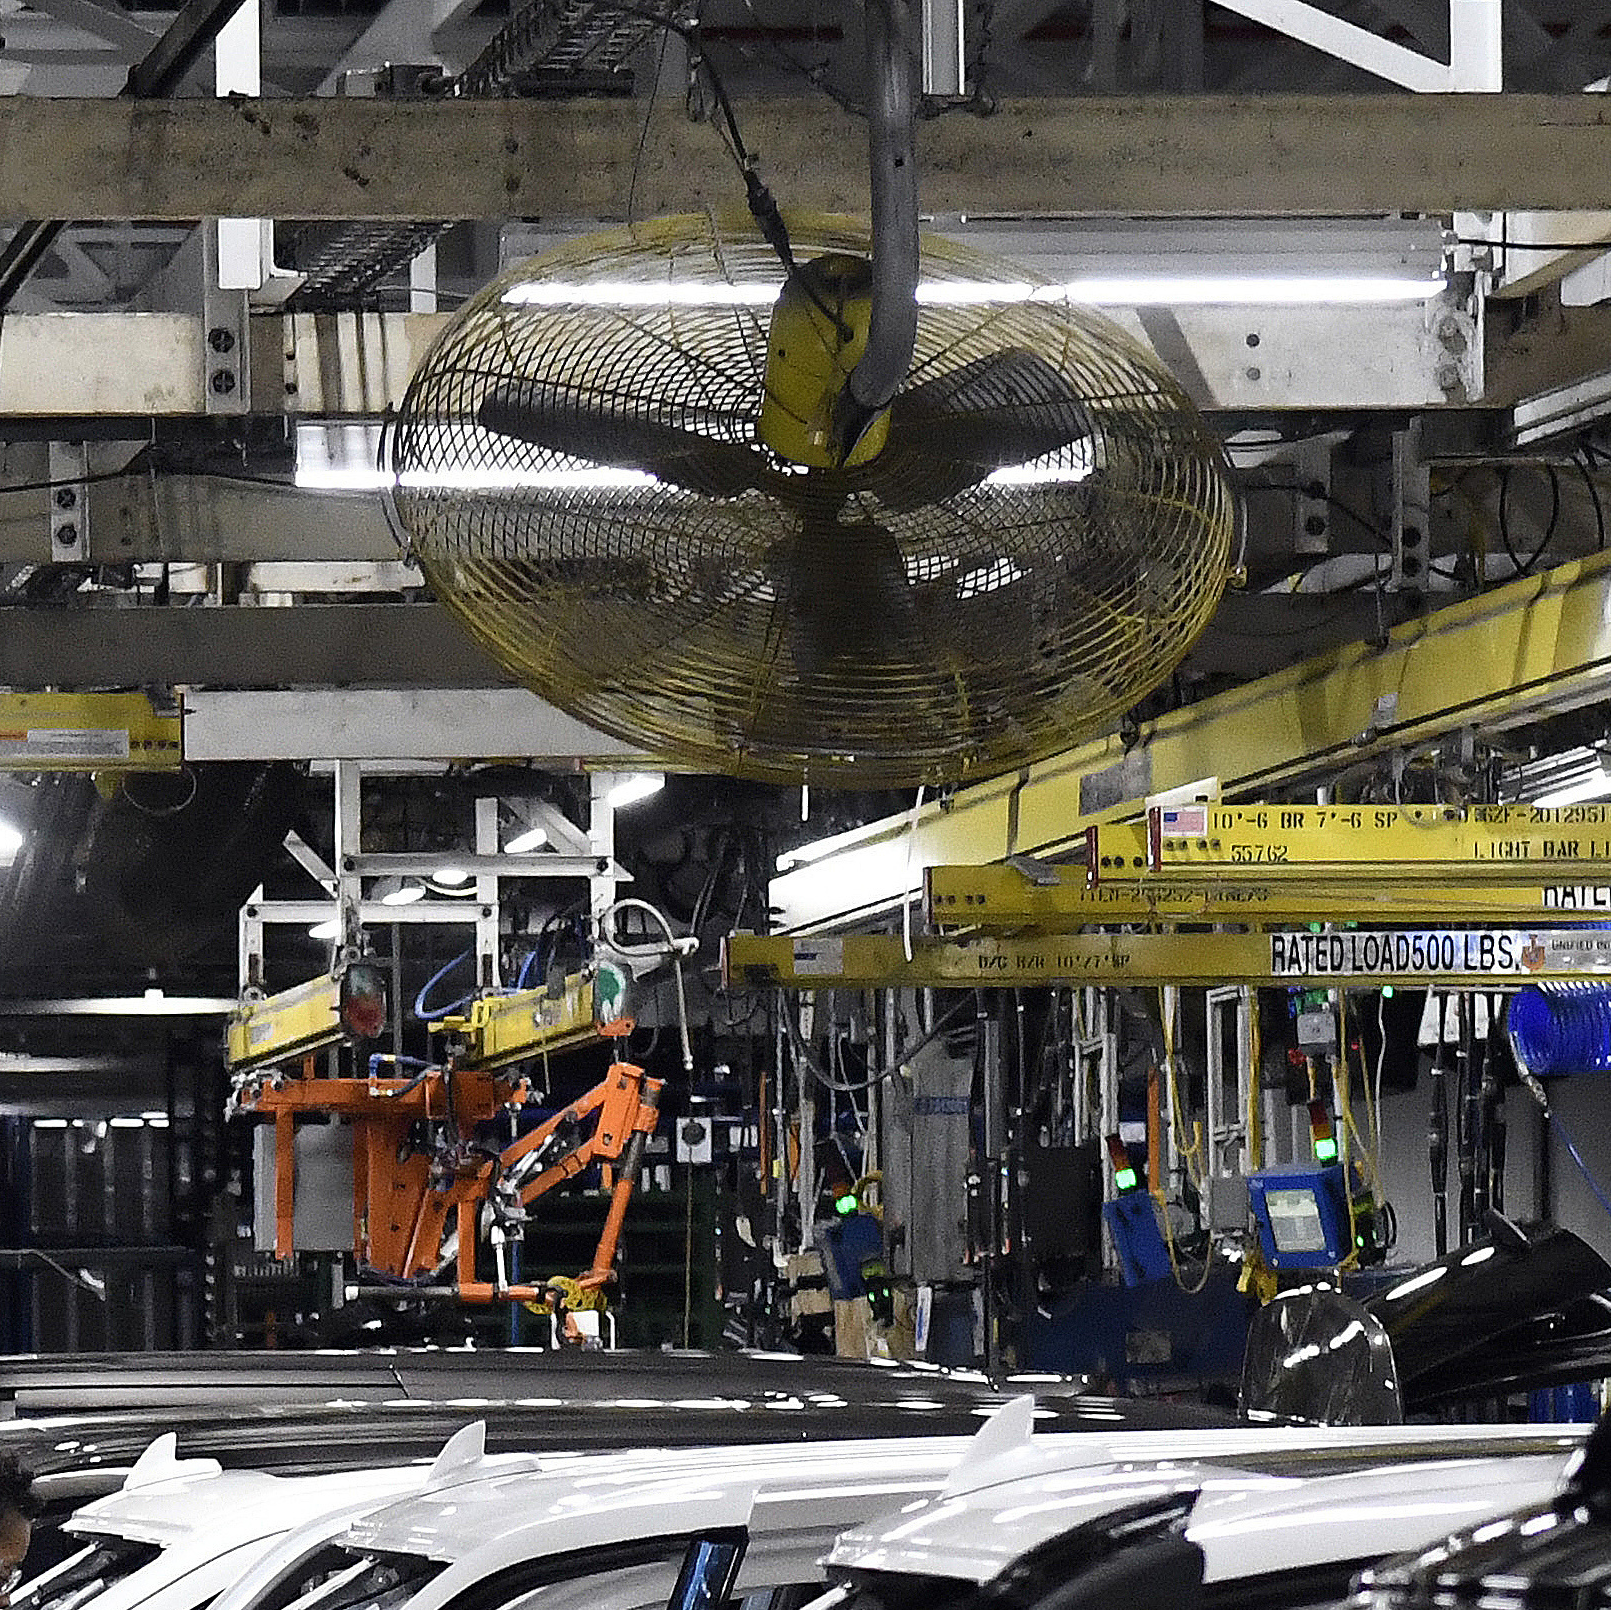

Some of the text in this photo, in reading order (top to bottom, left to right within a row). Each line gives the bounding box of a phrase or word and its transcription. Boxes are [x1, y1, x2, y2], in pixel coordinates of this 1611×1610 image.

[1374, 811, 1399, 828] SP
[1544, 886, 1611, 908] RATE
[1271, 934, 1344, 975] RATED
[1463, 934, 1521, 971] LBS.
